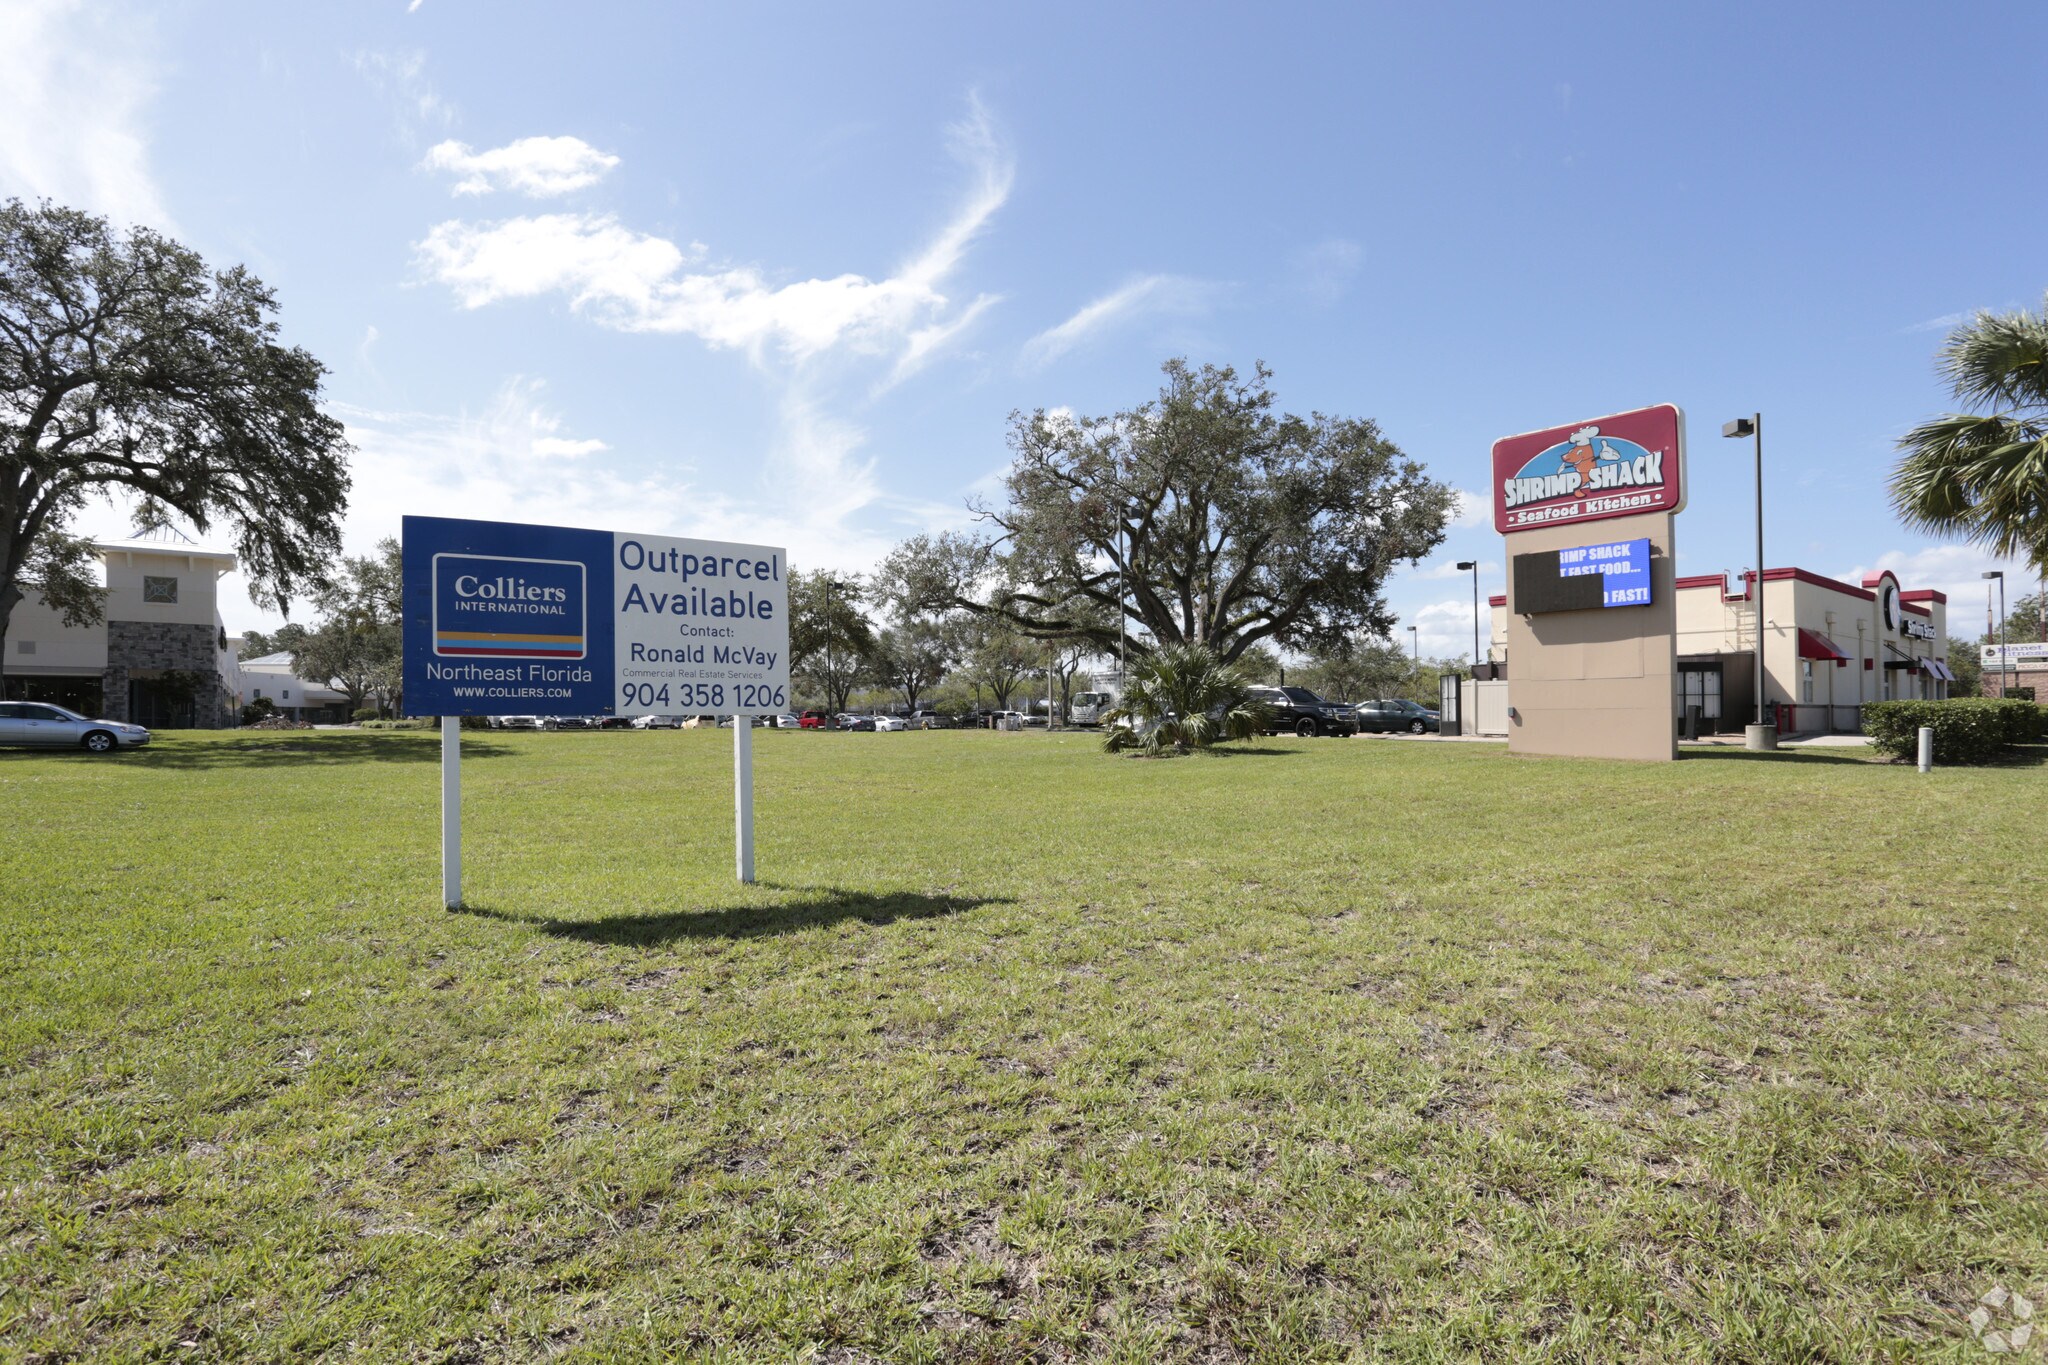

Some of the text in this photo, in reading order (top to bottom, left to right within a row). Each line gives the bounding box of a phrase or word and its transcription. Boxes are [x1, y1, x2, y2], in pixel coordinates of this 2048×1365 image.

[1504, 452, 1664, 508] SHRIMP SHACK
[1517, 493, 1652, 524] Seafood Kitchen
[619, 540, 779, 583] Outparcel
[1588, 544, 1631, 560] SHACK
[454, 575, 567, 602] Colliers
[1611, 587, 1648, 603] FAST!
[455, 601, 566, 615] INTERNATIONAL
[621, 583, 773, 620] Available
[680, 624, 734, 638] Contact:
[631, 643, 777, 670] Ronald McVay
[426, 662, 592, 682] Northeast Florida
[622, 668, 763, 680] Commercial Real Estate Services
[453, 687, 572, 698] WWW.COLLIERS.COM
[622, 682, 785, 708] 904 358 1206
